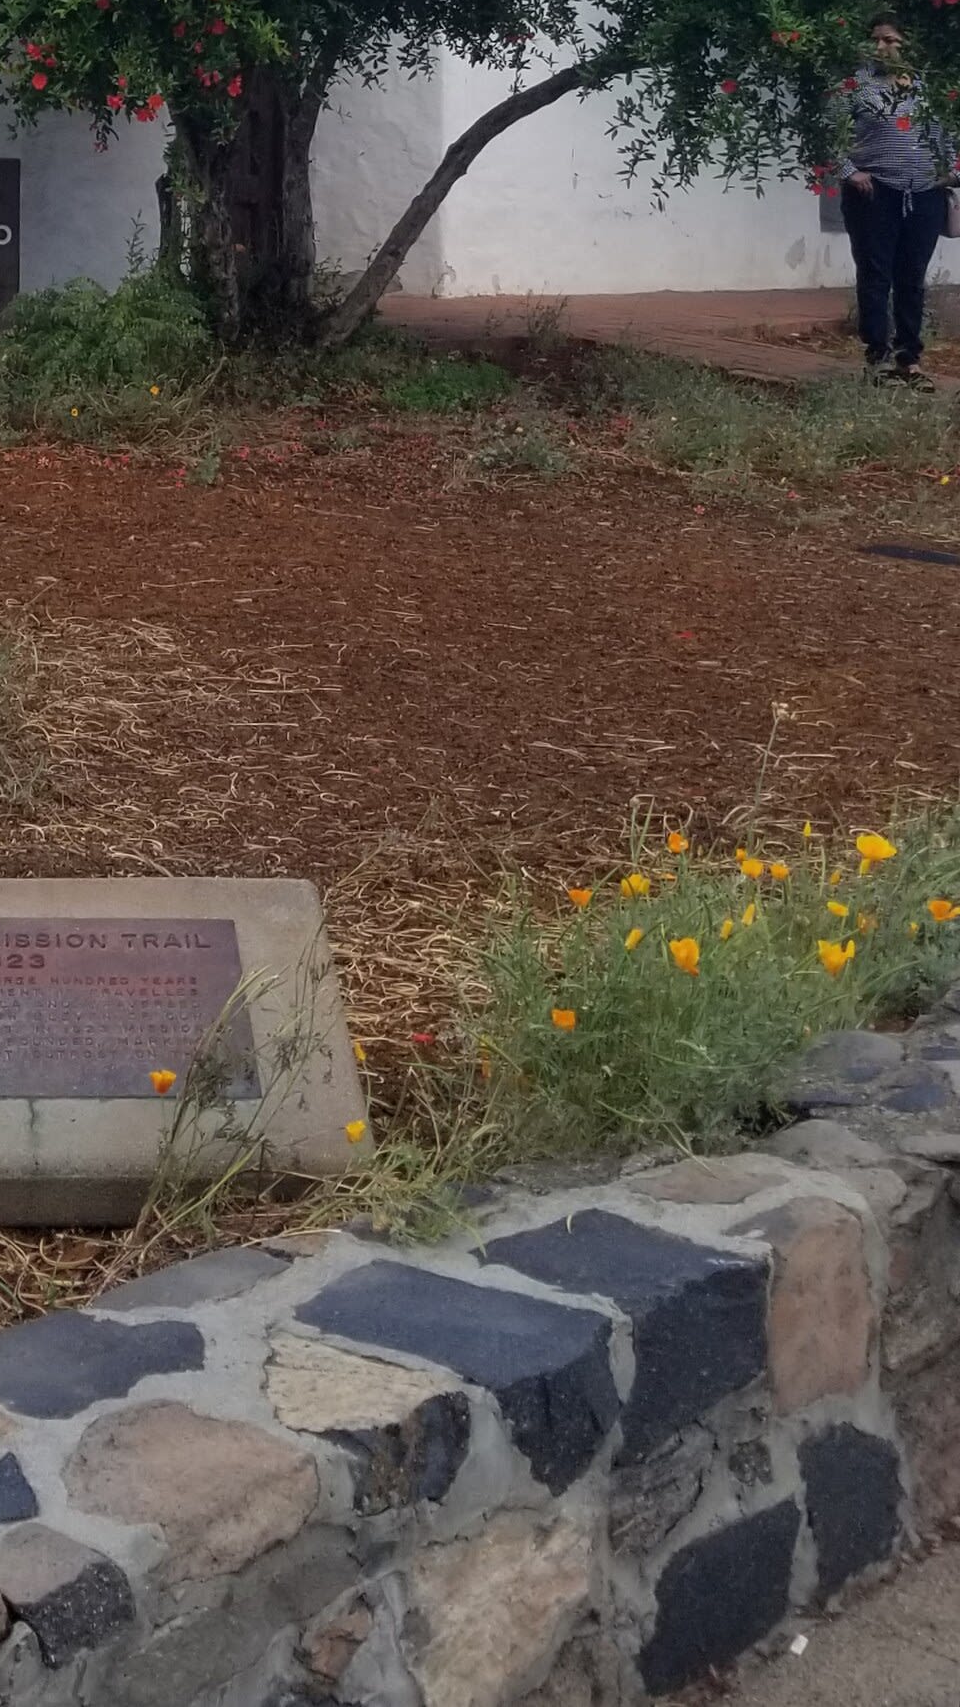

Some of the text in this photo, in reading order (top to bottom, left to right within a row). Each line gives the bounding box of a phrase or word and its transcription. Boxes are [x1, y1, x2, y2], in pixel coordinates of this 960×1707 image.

[121, 933, 212, 949] TRAIL
[50, 976, 129, 986] HUNDRED
[140, 976, 197, 986] YEARS
